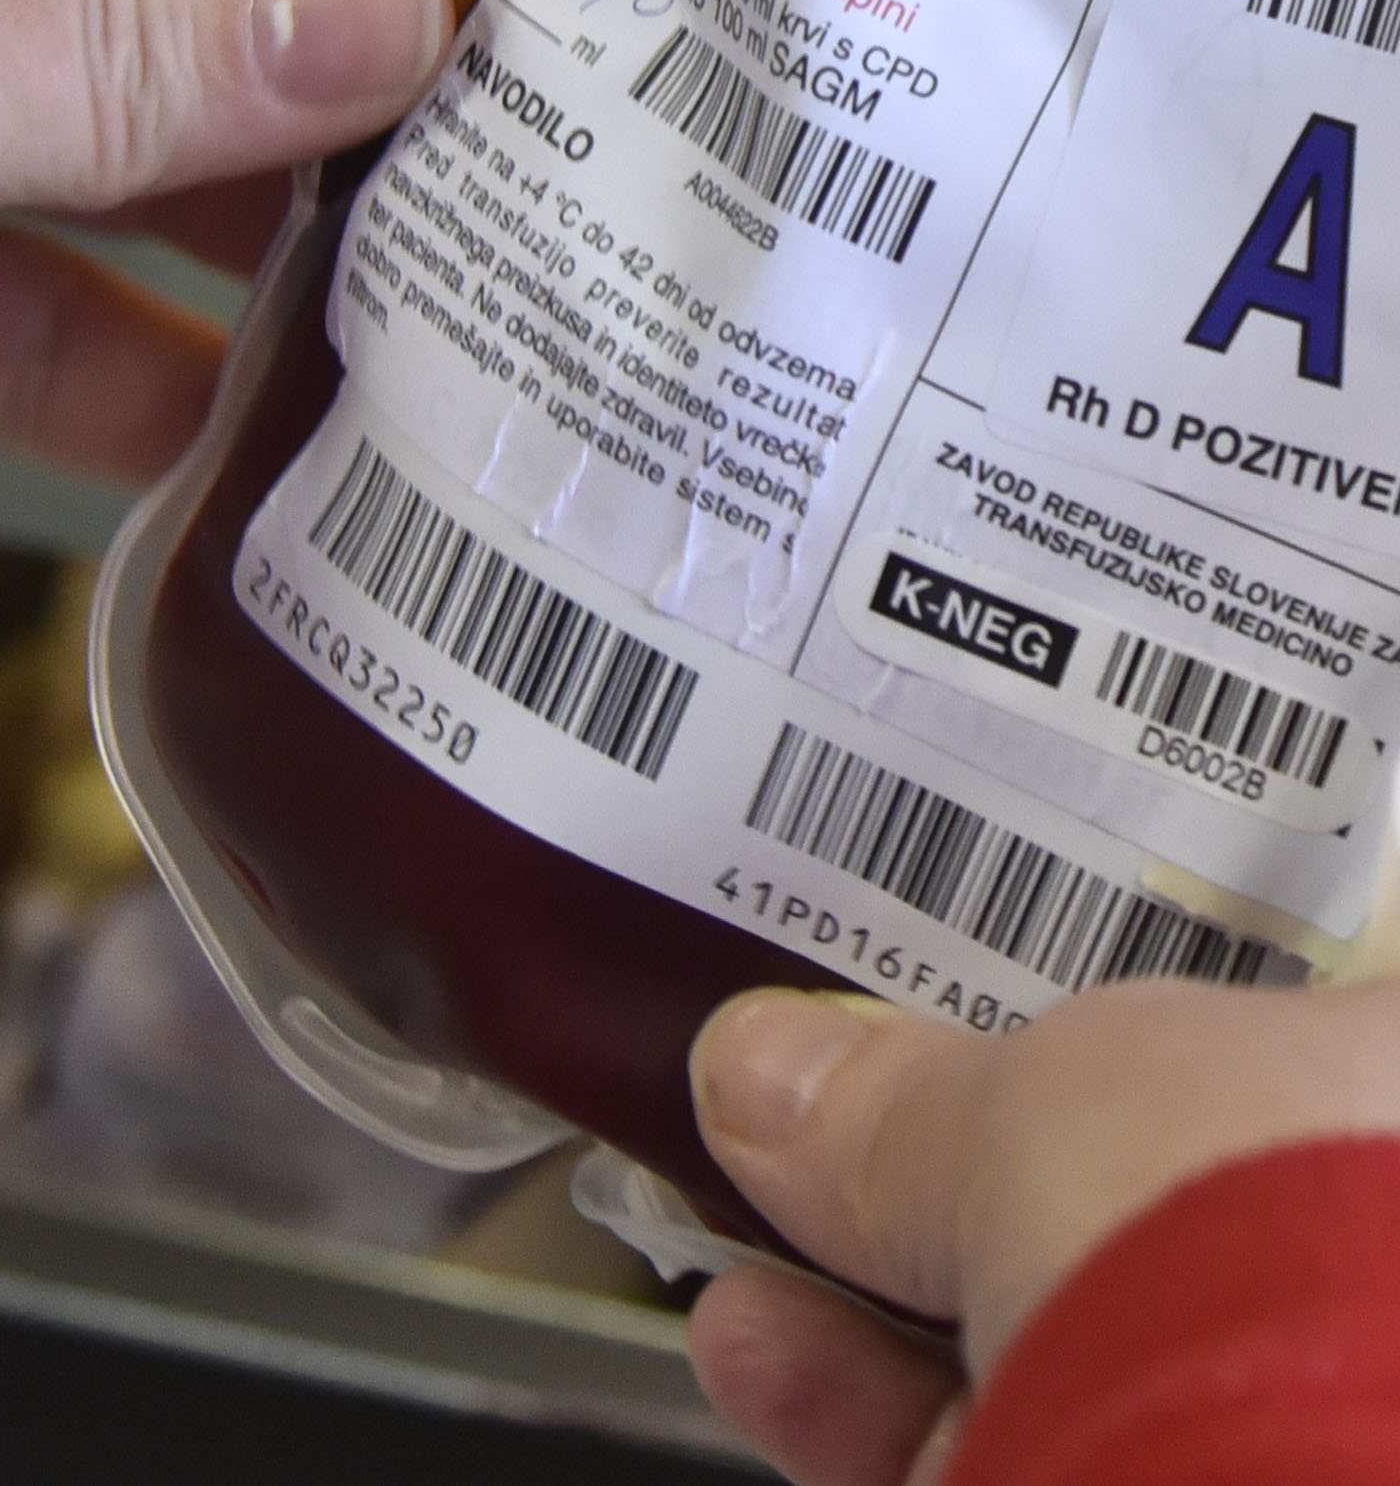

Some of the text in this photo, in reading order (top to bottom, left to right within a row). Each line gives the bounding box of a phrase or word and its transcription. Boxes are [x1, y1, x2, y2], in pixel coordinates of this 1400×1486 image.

[456, 40, 595, 162] NAVODILO
[569, 33, 608, 68] ml
[747, 26, 770, 64] ml
[769, 41, 883, 122] SAGM
[777, 3, 832, 50] krvi
[833, 36, 854, 62] s
[861, 46, 939, 100] CPD
[402, 121, 456, 181] Pred
[458, 170, 576, 279] transfuzijo
[584, 277, 700, 370] preverite
[425, 88, 488, 160] Hranite
[487, 147, 516, 184] na
[519, 173, 550, 205] +4
[582, 220, 614, 254] do
[618, 245, 654, 282] 42
[653, 270, 692, 310] dni
[688, 298, 718, 331] od
[718, 319, 858, 403] odvzema
[1183, 111, 1358, 391] A
[356, 232, 401, 291] dobro
[400, 279, 516, 384] premešajte
[517, 364, 542, 404] in
[546, 391, 666, 486] uporabite
[675, 475, 772, 544] sistem
[388, 217, 465, 300] pacienta.
[470, 280, 503, 325] Ne
[505, 311, 600, 399] dodajajte
[600, 385, 689, 458] zdravil.
[491, 255, 593, 345] preizkusa
[592, 326, 618, 363] in
[616, 342, 728, 433] identiteto
[1046, 375, 1110, 429] Rh
[1124, 398, 1161, 441] D
[890, 570, 1055, 672] K-NEG
[934, 441, 1037, 505] ZAVOD
[1041, 490, 1207, 580] REPUBLIKE
[1208, 566, 1370, 652] SLOVENIJE
[973, 492, 1355, 679] TRANSFUZIJSKO MEDICINO
[1136, 724, 1269, 802] D6002B
